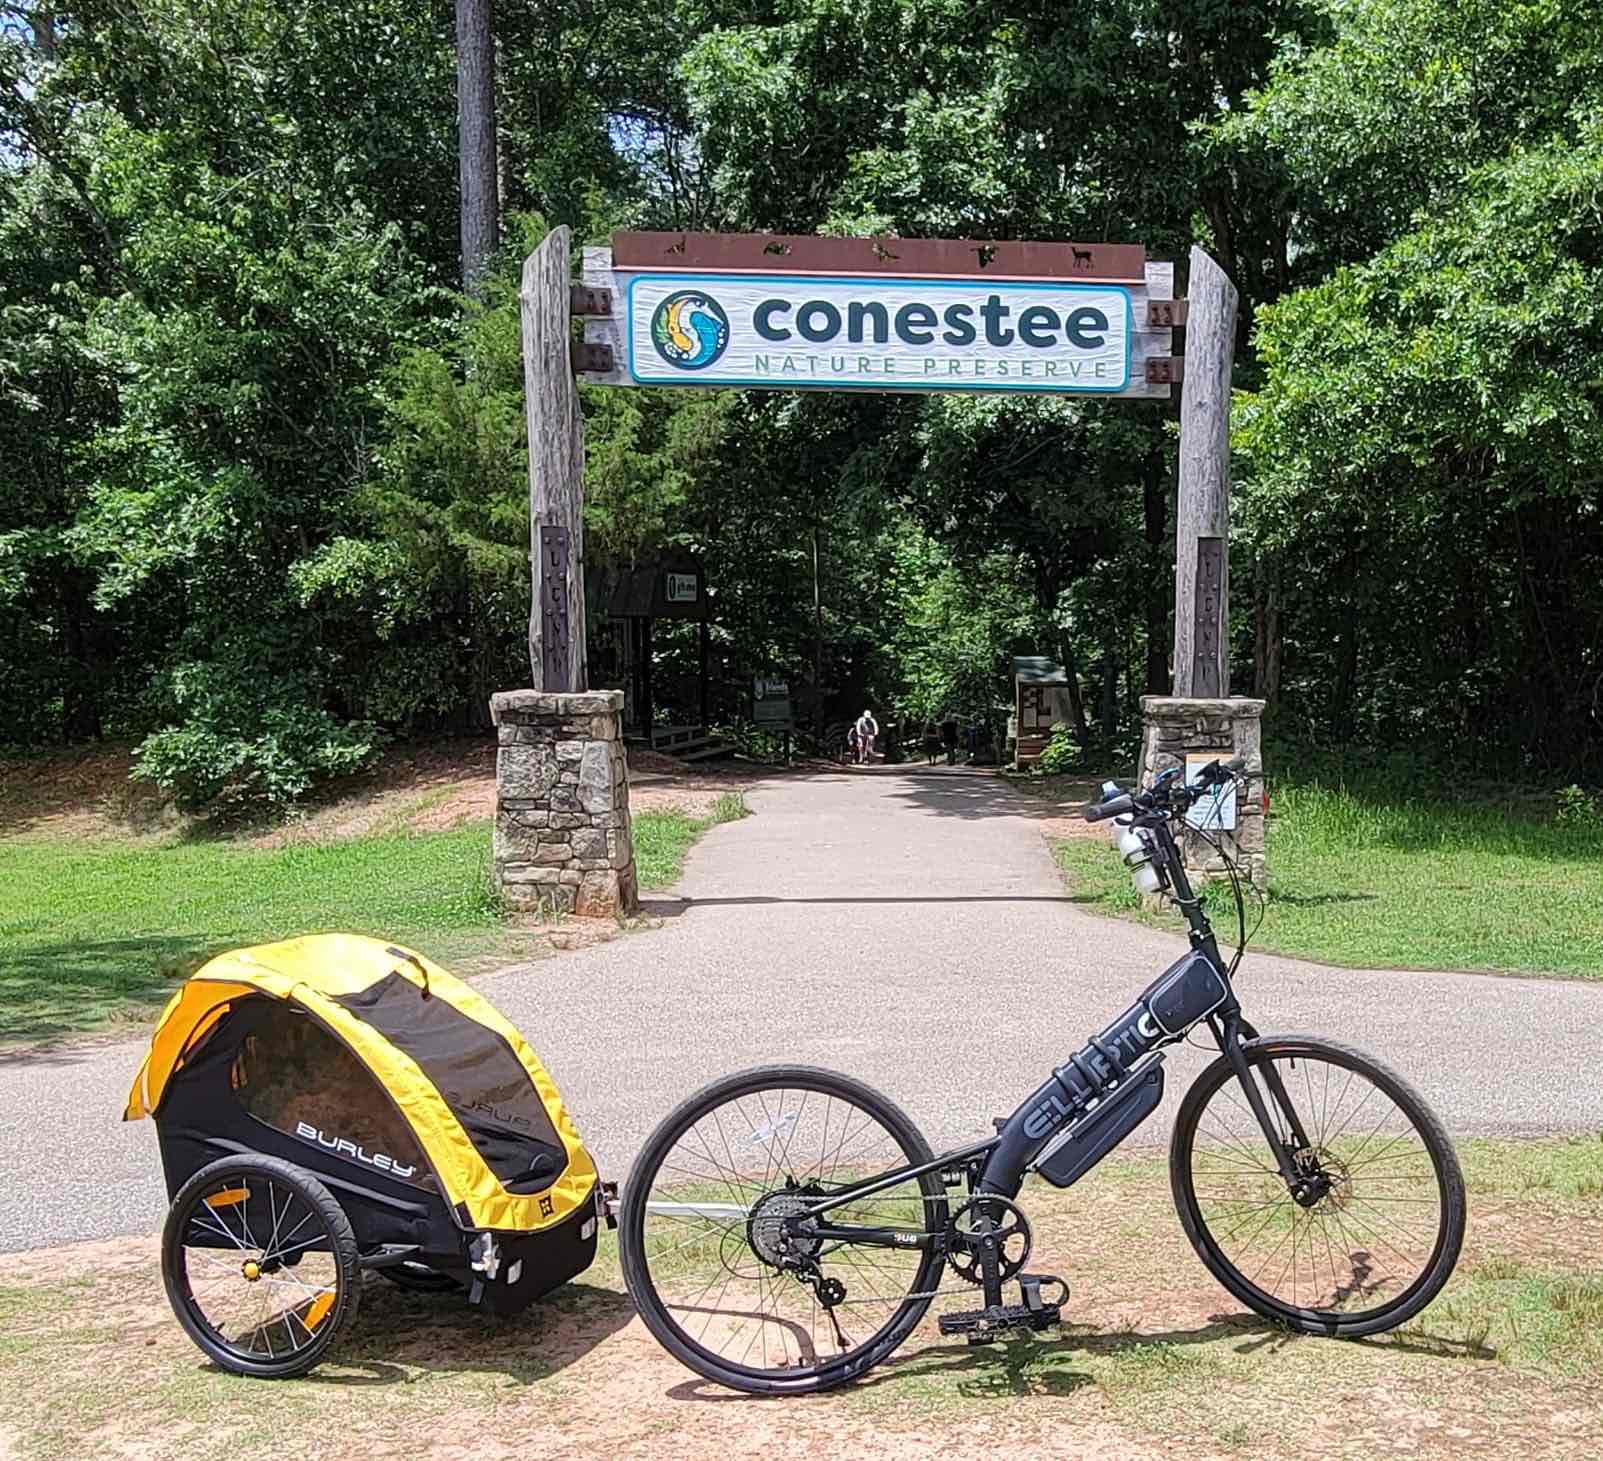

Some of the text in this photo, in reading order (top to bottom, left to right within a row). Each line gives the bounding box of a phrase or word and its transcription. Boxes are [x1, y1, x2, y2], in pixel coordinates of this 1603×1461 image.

[753, 294, 1109, 349] conestee
[754, 355, 1107, 379] NATURE PRESERVE
[296, 1121, 416, 1178] BURLEY
